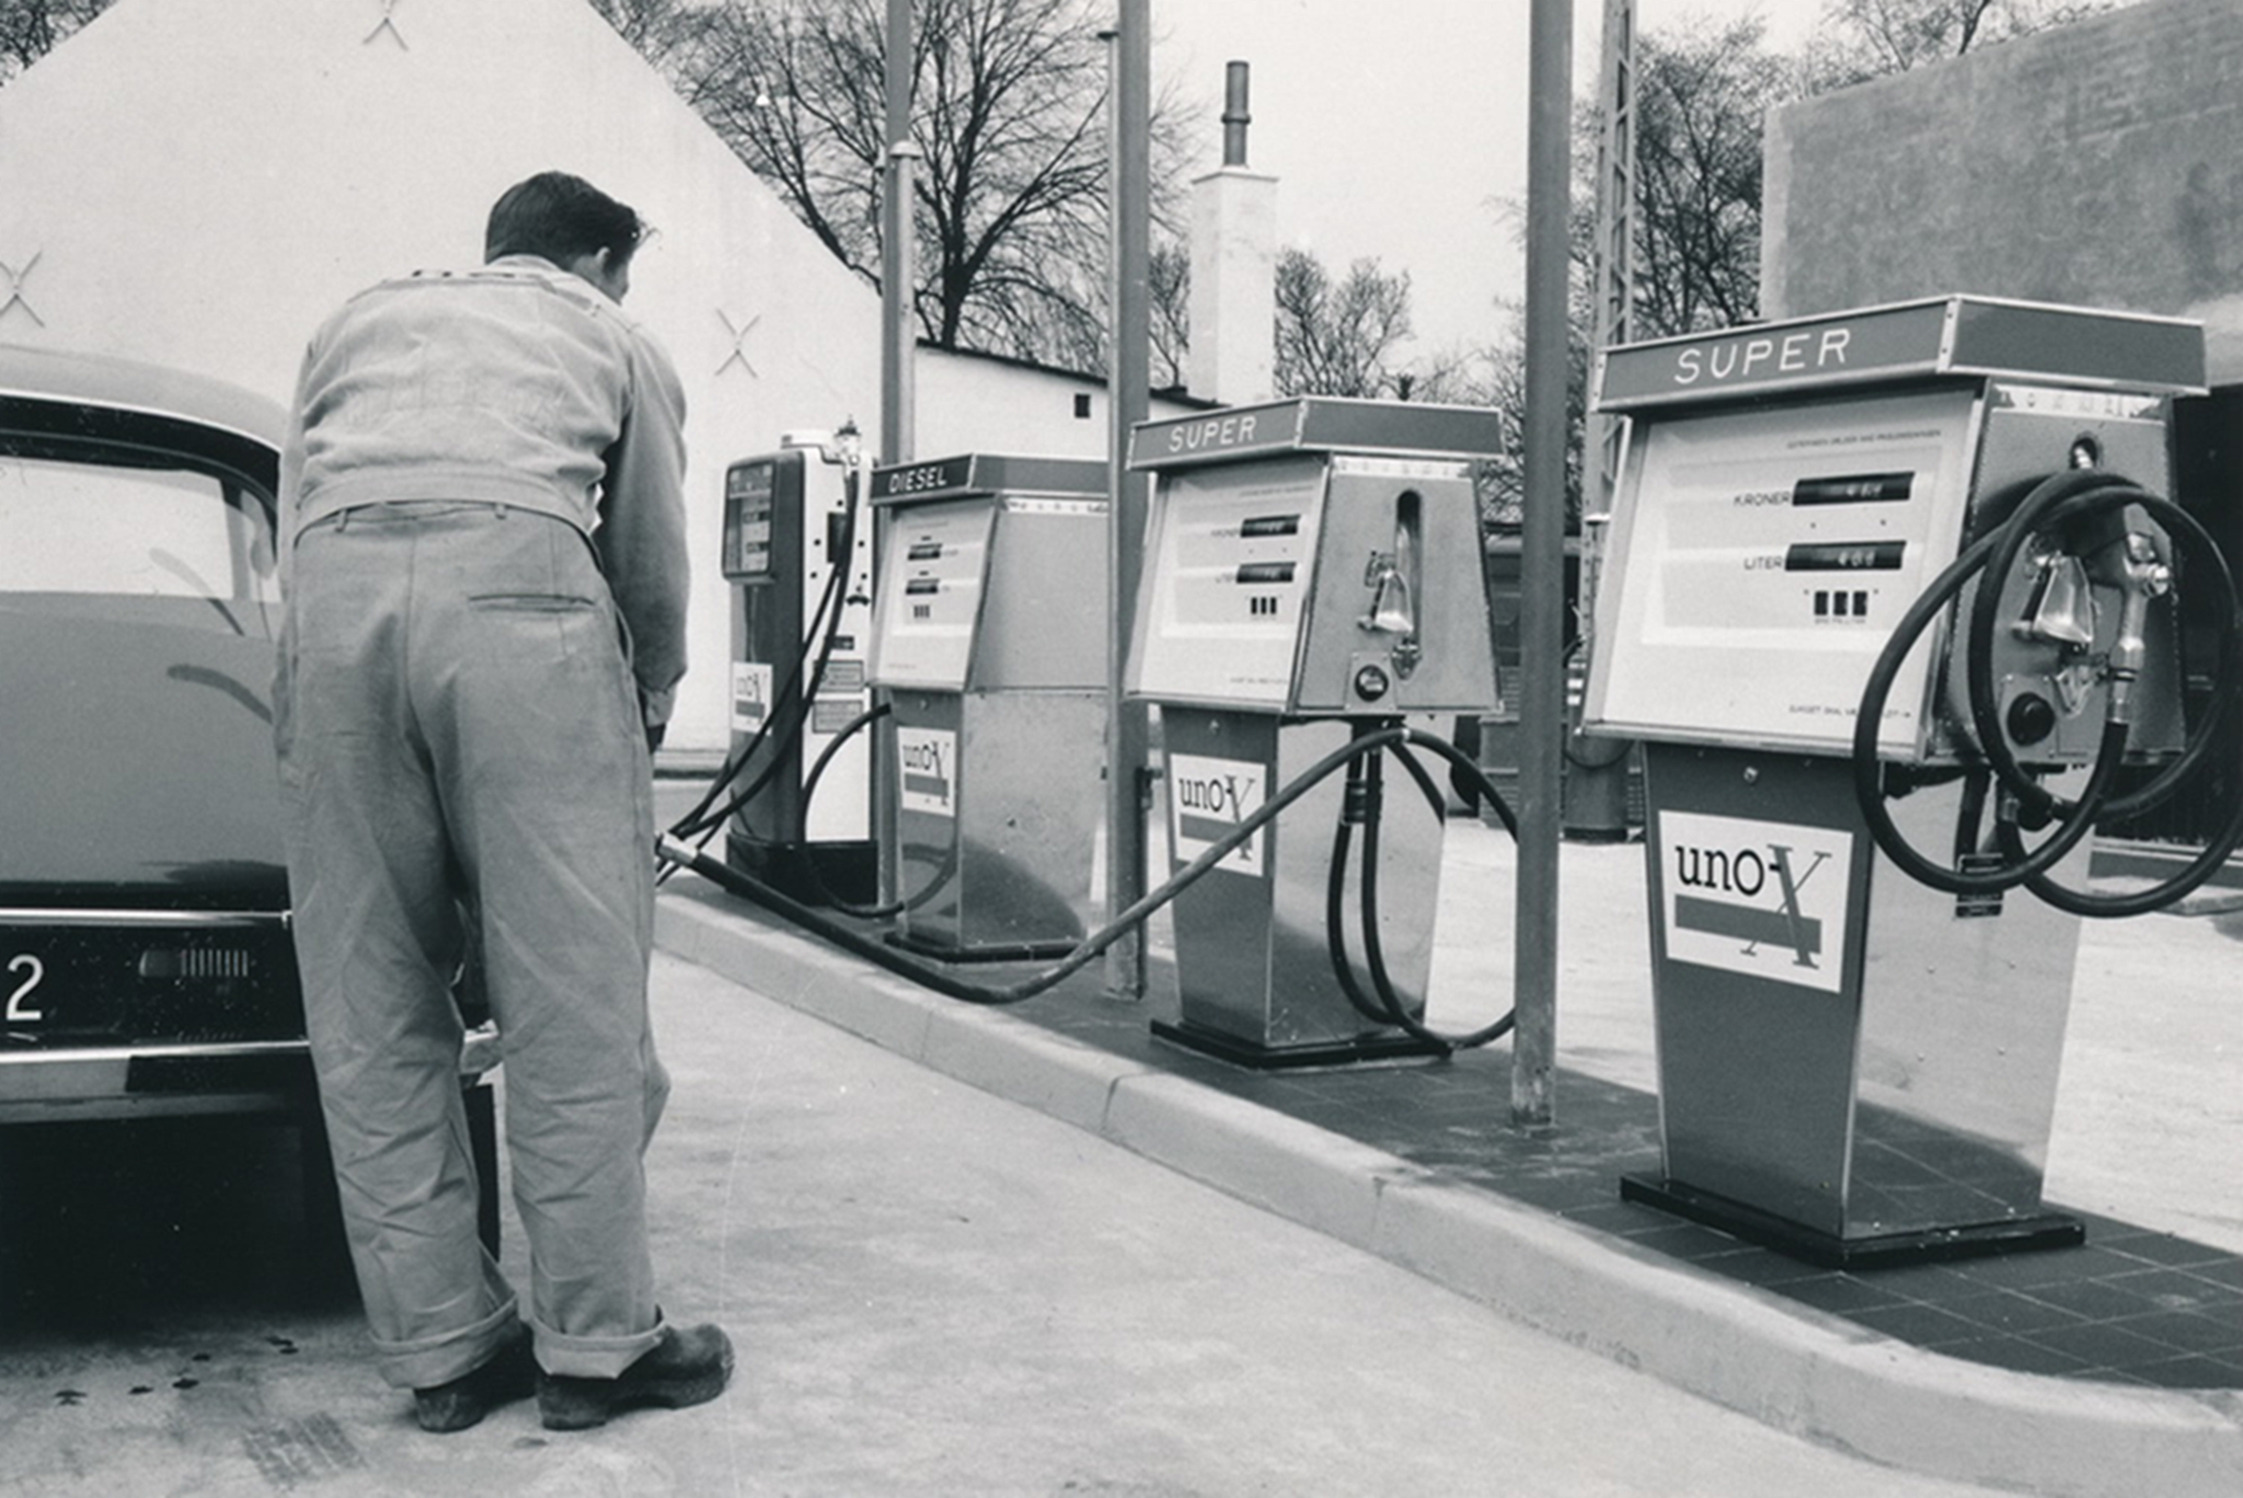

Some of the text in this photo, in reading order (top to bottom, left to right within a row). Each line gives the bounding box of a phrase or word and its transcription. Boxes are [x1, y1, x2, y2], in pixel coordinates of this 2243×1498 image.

[1674, 327, 1852, 385] SUPER
[1168, 416, 1258, 453] SUPER
[888, 466, 947, 494] DIESEL
[1744, 556, 1784, 571] LITER
[1674, 843, 1832, 970] uno-X
[5, 953, 45, 1022] 2
